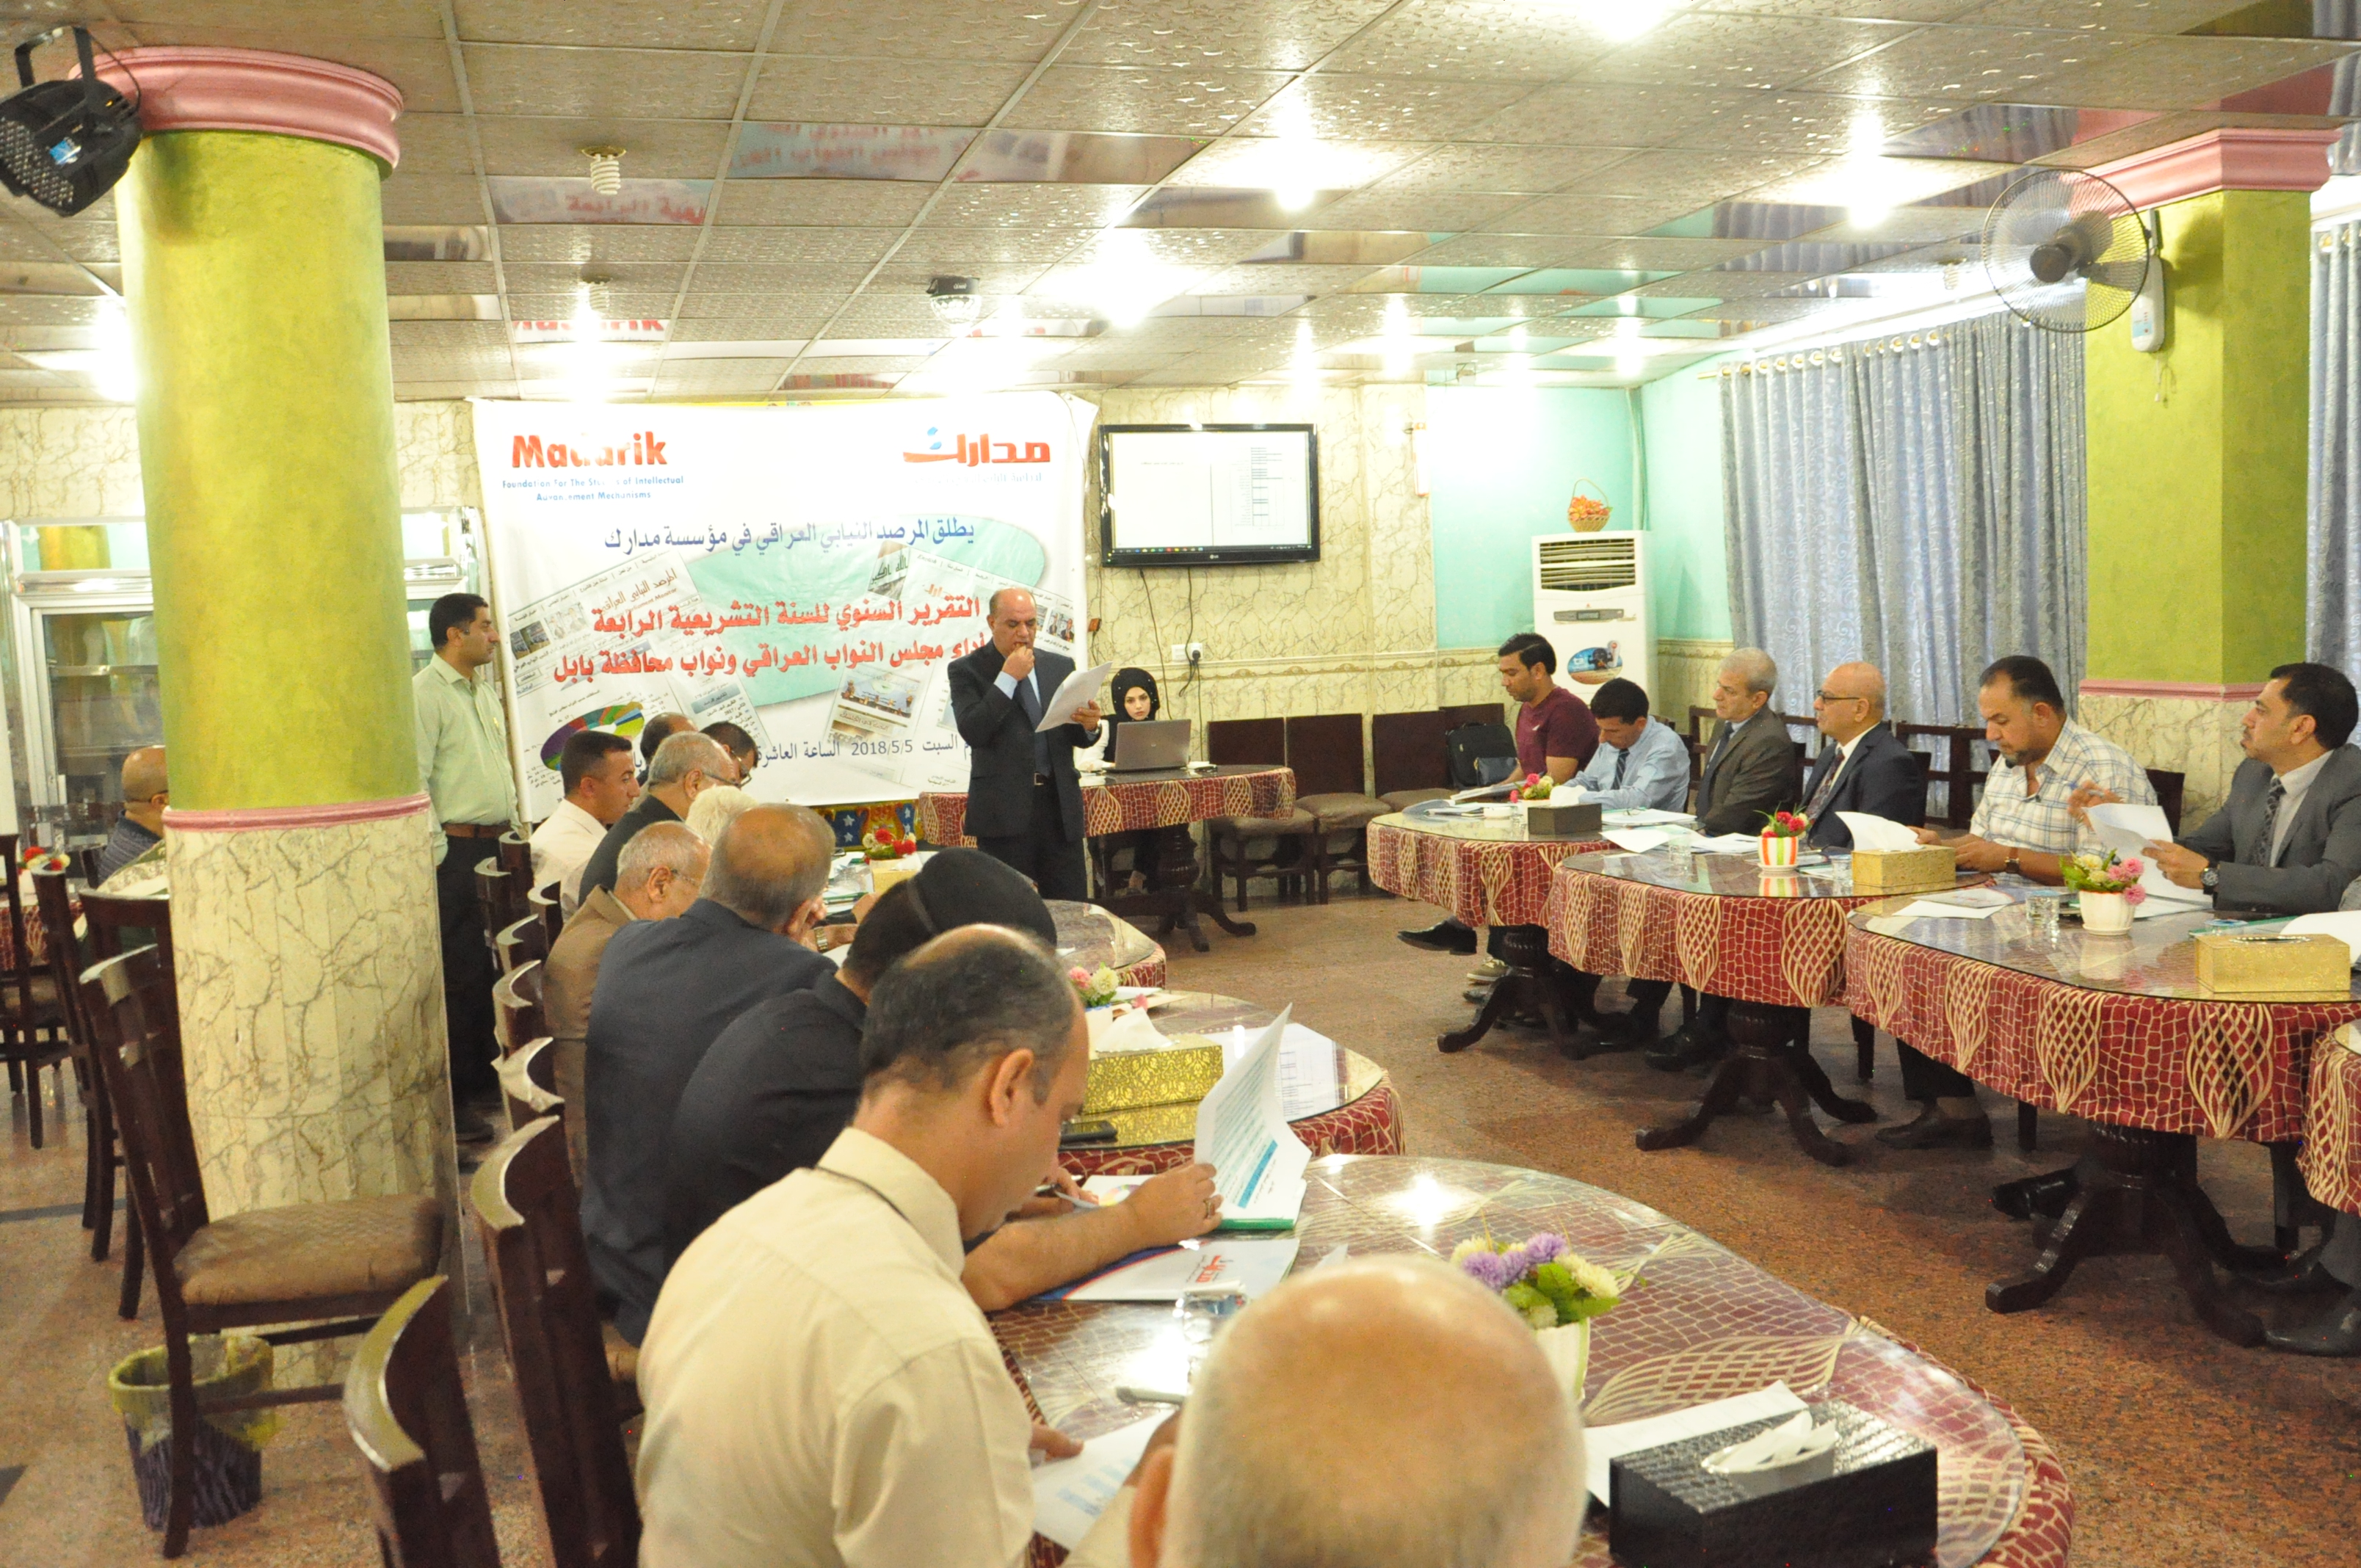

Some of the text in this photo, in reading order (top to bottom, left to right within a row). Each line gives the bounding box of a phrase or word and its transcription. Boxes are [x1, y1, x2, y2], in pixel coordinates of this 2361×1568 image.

[903, 427, 1051, 467] مدارك
[502, 476, 683, 488] Foundation For The Stus of Intellectual
[537, 491, 651, 501] Avanement Mechanisms
[604, 516, 974, 556] يطلق المرصد النيابي العراقي في مؤسسة مدارك
[655, 588, 678, 600] Monitor
[591, 608, 663, 639] الرابعة
[668, 600, 769, 636] التشريعية
[775, 600, 830, 625] للسنة
[836, 599, 902, 631] السنوي
[907, 595, 980, 625] التقرير
[599, 649, 673, 675] محافظة
[681, 646, 736, 678] ونواب
[743, 643, 817, 677] العراقي
[824, 640, 884, 671] النواب
[890, 640, 943, 667] مجلس
[554, 654, 594, 683] بابل
[757, 742, 797, 767] العاشرة
[804, 740, 840, 758] الساعة
[851, 739, 913, 756] 2018/5/5
[922, 734, 958, 755] السبت
